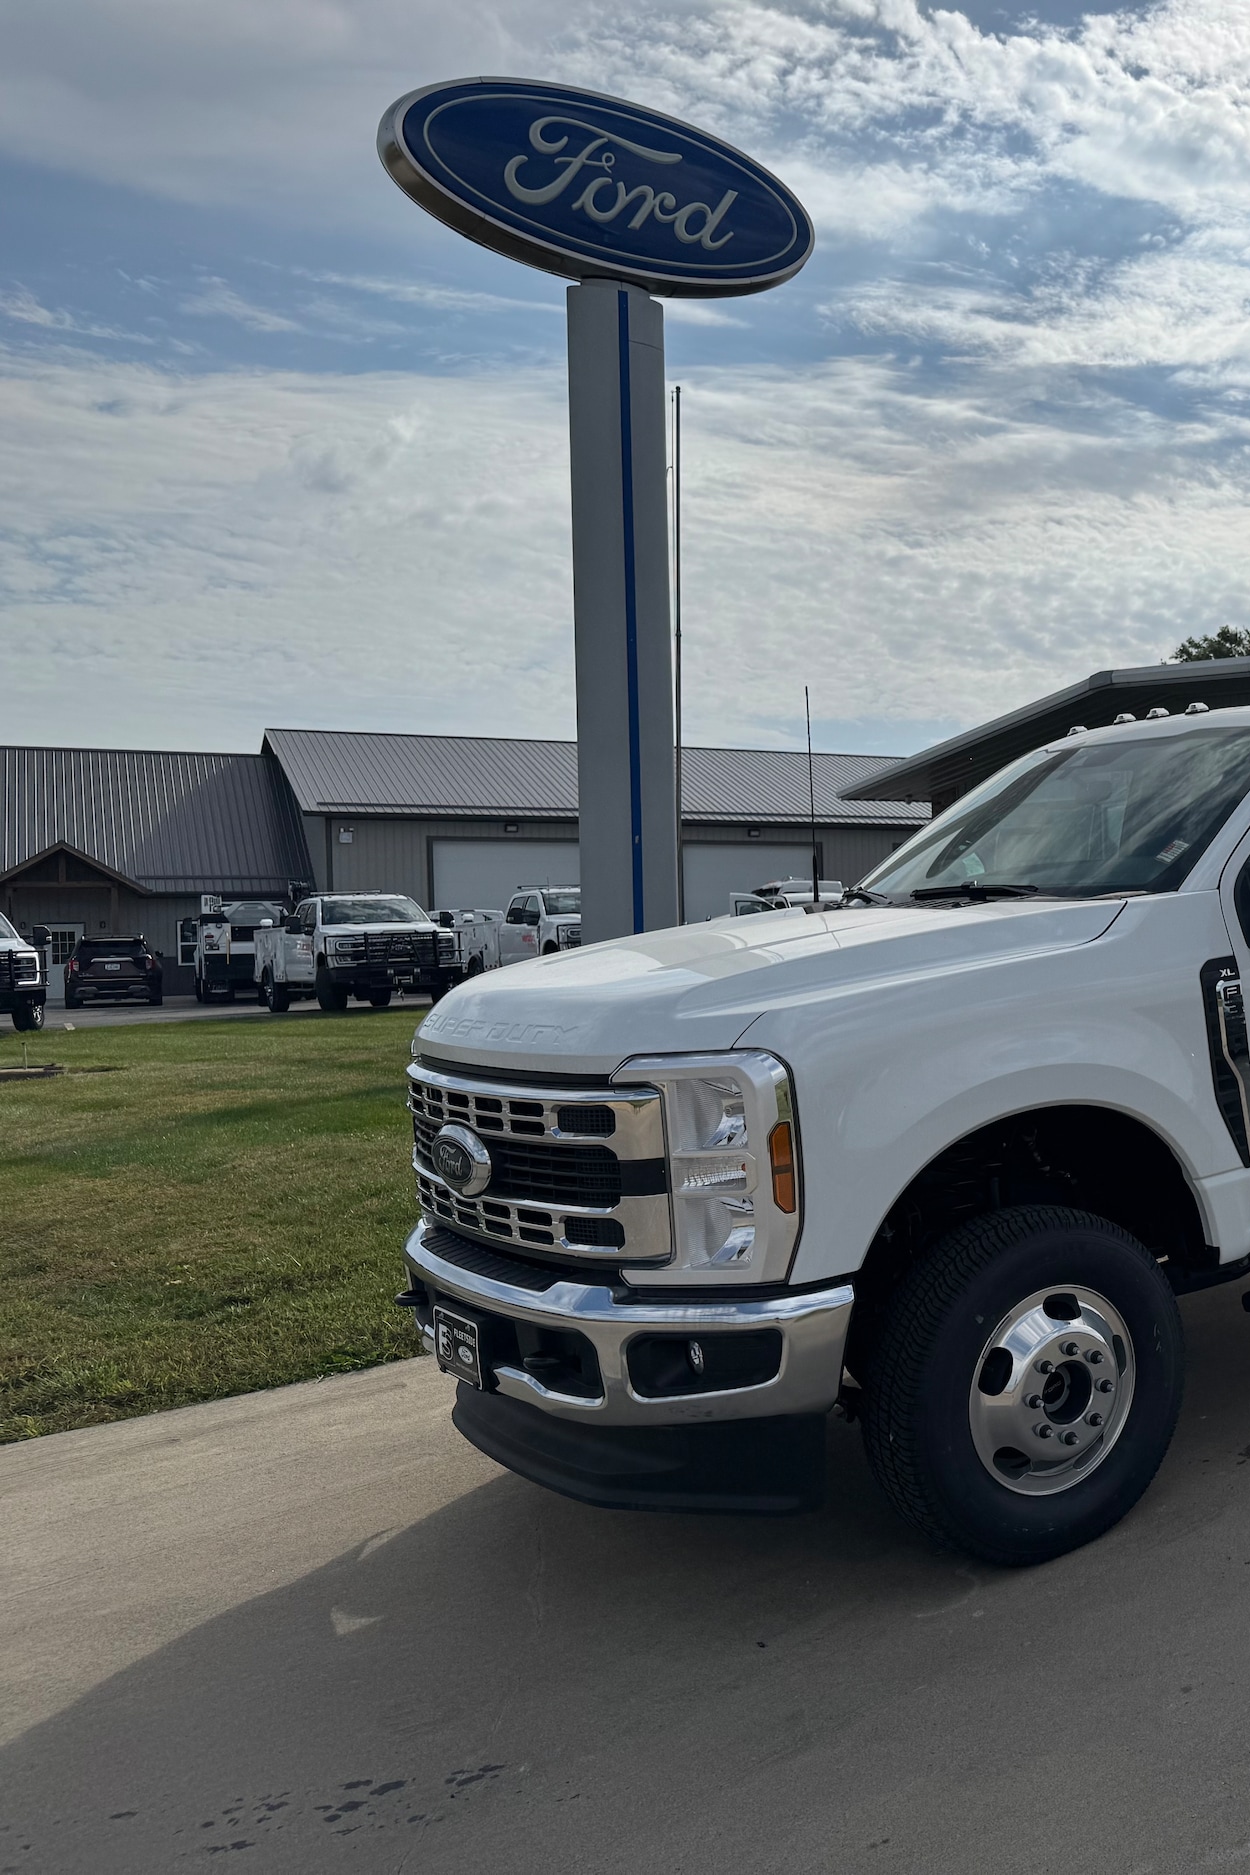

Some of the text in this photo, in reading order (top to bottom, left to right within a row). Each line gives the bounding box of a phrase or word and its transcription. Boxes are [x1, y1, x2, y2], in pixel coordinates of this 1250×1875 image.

[504, 116, 739, 250] Ford
[1219, 968, 1236, 977] XL
[424, 1013, 579, 1046] SUPER DUTY
[438, 1144, 464, 1177] Ford
